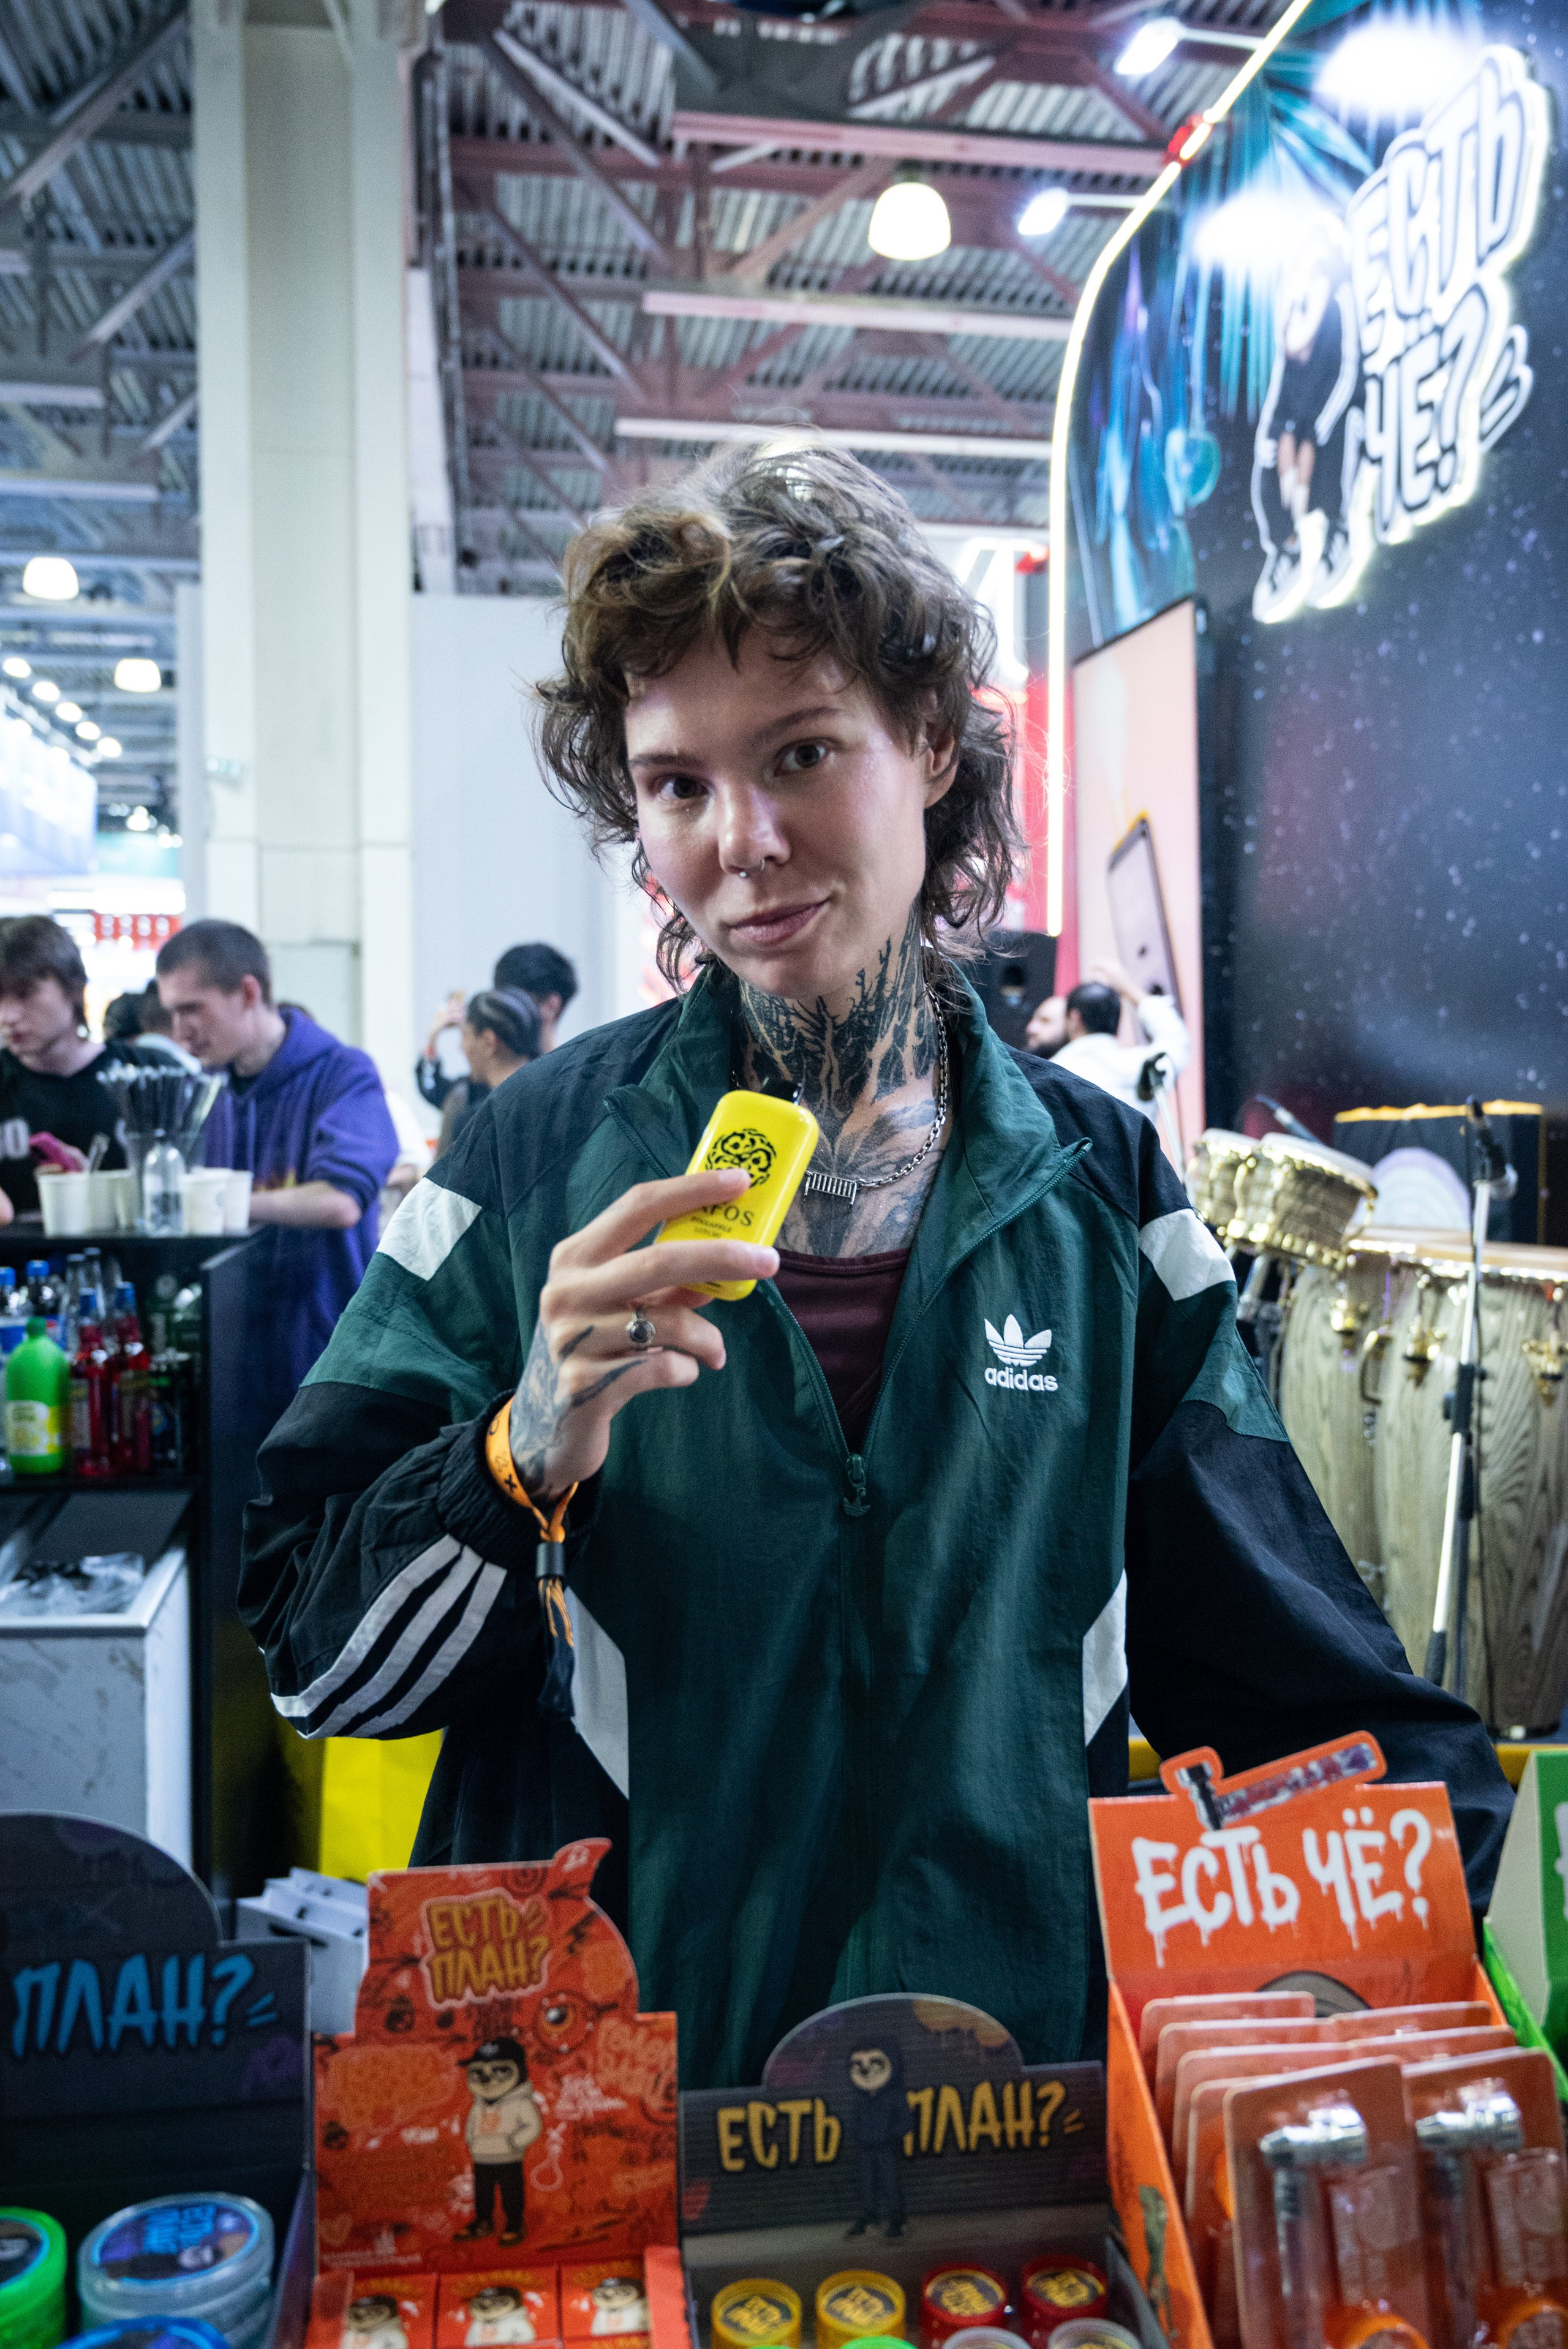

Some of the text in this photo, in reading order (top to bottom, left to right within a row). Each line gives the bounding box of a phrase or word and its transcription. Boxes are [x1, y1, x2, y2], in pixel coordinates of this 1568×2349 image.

[1350, 60, 1525, 356] ЕСТЬ
[702, 1201, 755, 1227] FOS
[984, 1367, 1058, 1391] adidas
[1132, 1826, 1300, 1963] ЕСТЬ
[1302, 1806, 1431, 1949] ЧЁ?
[430, 1899, 519, 1948] ЕСТЬ
[11, 1954, 254, 2057] ПЛАН?
[430, 1936, 549, 1999] ПЛАН?
[717, 2081, 1065, 2171] ЕСТЬ ПЛАН?
